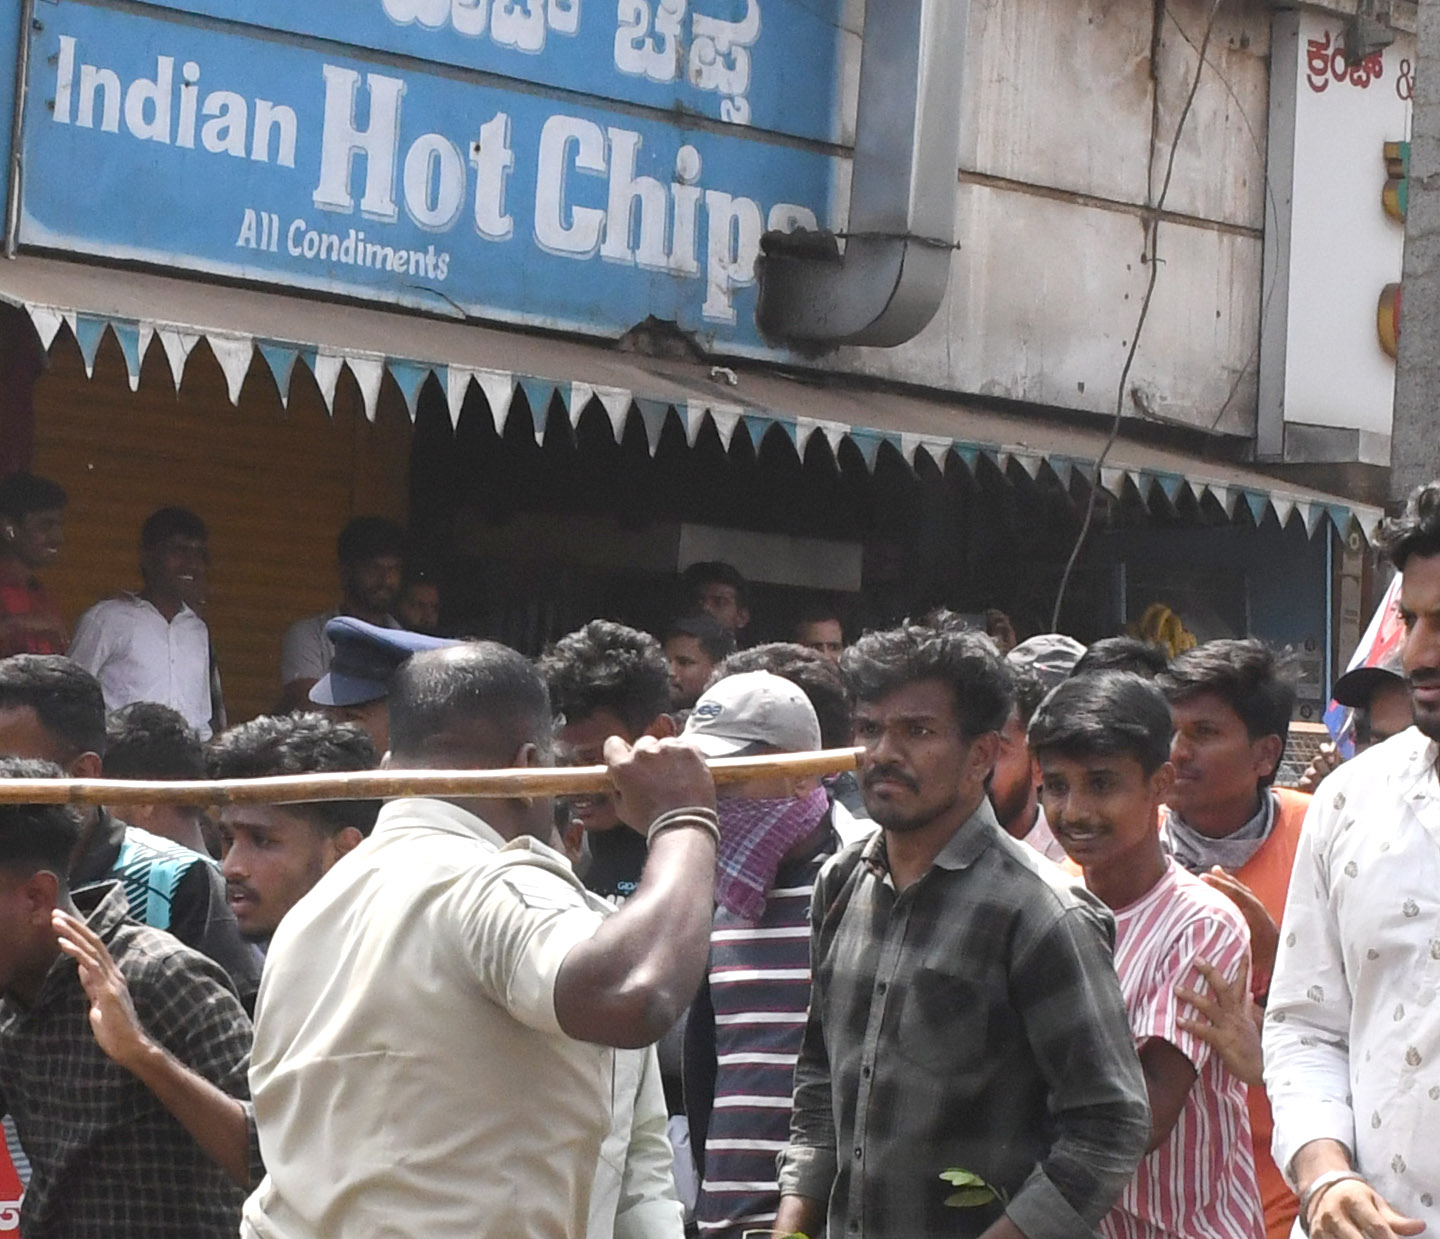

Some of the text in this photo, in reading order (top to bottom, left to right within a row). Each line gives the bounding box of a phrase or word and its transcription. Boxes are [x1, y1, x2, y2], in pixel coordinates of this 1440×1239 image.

[51, 34, 298, 169] Indian
[311, 63, 516, 241] Hot
[235, 207, 452, 282] All Condiments
